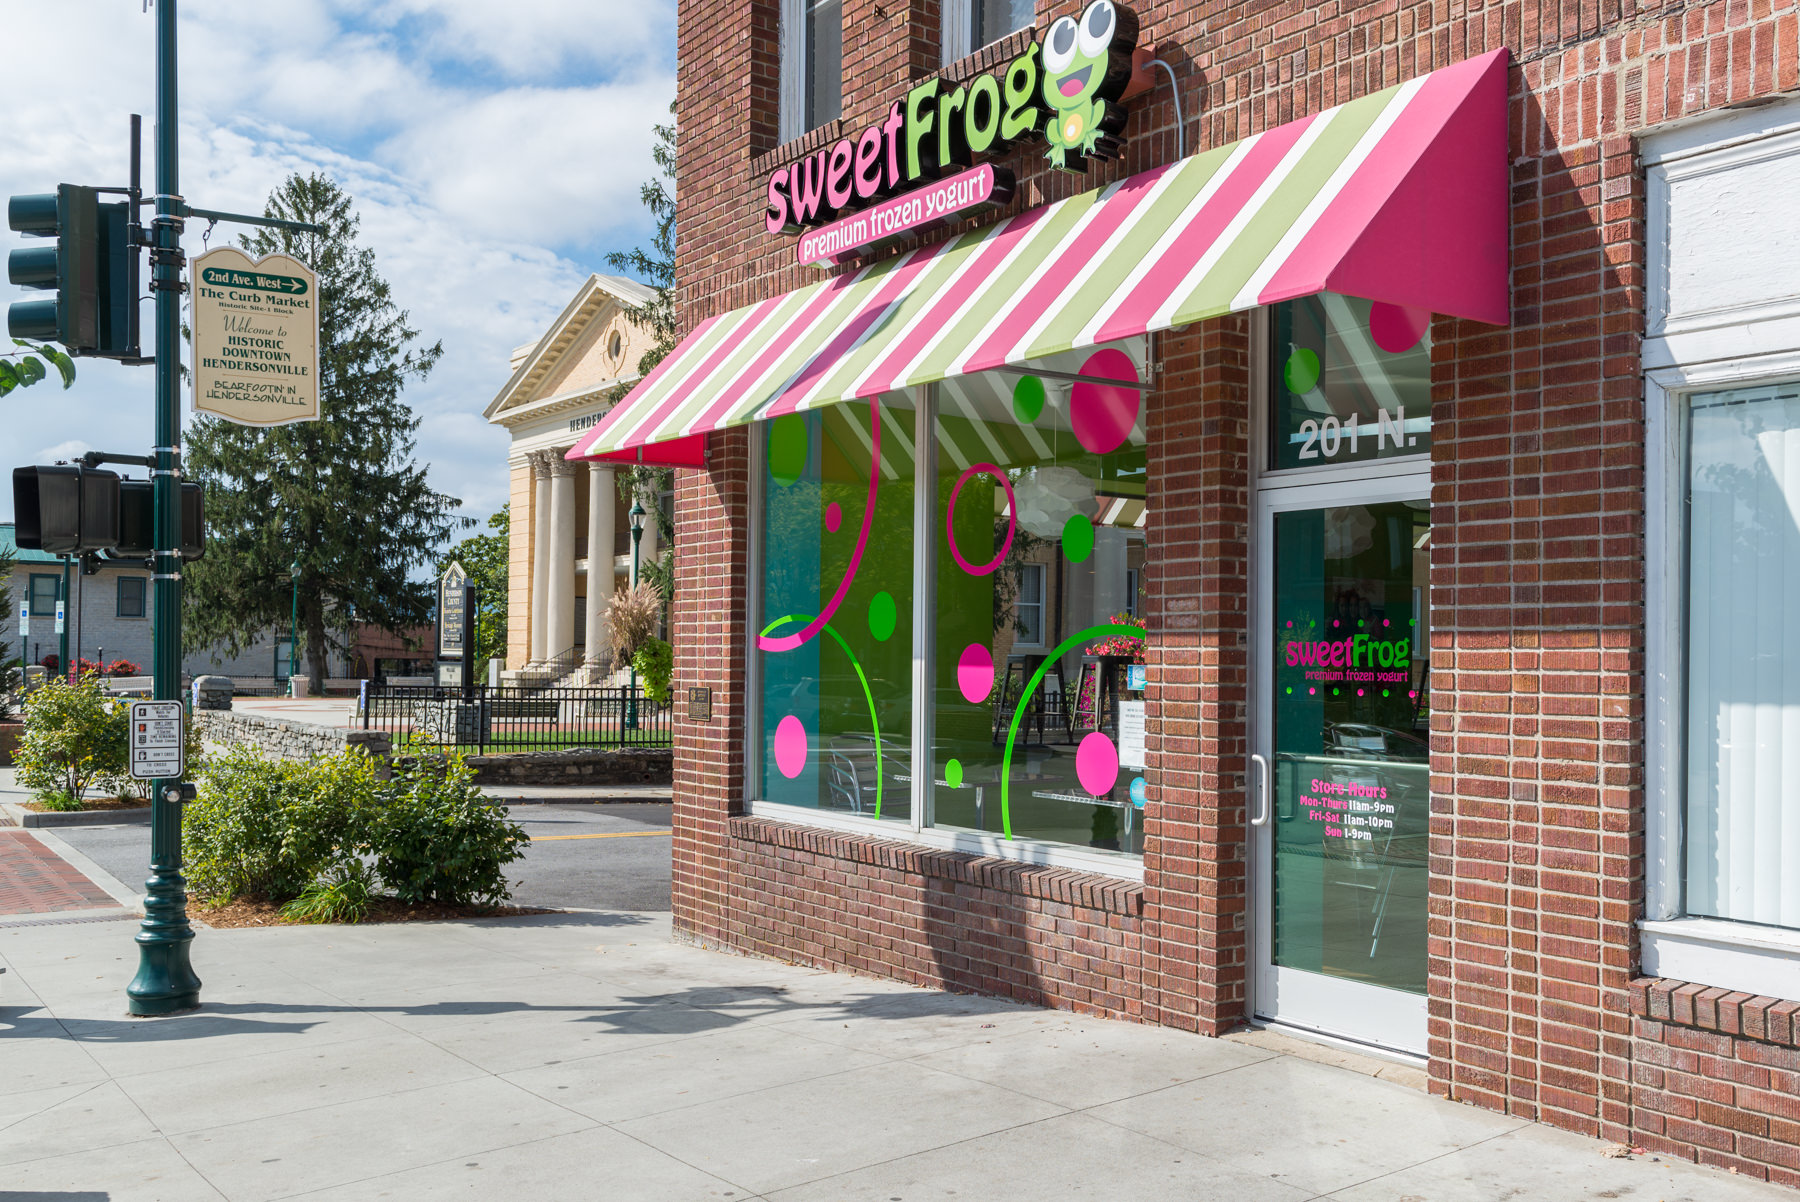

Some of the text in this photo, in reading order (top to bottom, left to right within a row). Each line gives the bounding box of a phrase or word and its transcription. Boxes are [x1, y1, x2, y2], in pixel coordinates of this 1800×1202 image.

[765, 41, 1040, 234] sweetFrog
[803, 169, 986, 261] premium frozen yogurt
[208, 271, 282, 289] 2nd Ave. West
[199, 287, 310, 309] The Curb Market
[218, 302, 248, 310] Historic
[274, 307, 294, 315] Block
[223, 315, 288, 337] Welcome to
[228, 336, 284, 350] HISTORIC
[222, 347, 291, 362] DOWNTOWN
[203, 358, 308, 376] HENDERSONVILLE
[214, 380, 296, 394] BEARFOOTIN' IN
[206, 389, 307, 406] HENDERSONVILLE
[1298, 405, 1417, 460] 201 N.
[1286, 634, 1410, 668] sweetFrog
[1305, 669, 1408, 682] premium frozen yogurt
[1311, 779, 1387, 799] Store Hours
[1300, 795, 1394, 814] Mon-Thurs 11am-9pm
[1310, 810, 1393, 828] Fri-Sat 11am-10pm
[1325, 826, 1372, 840] Sun 1-9pm
